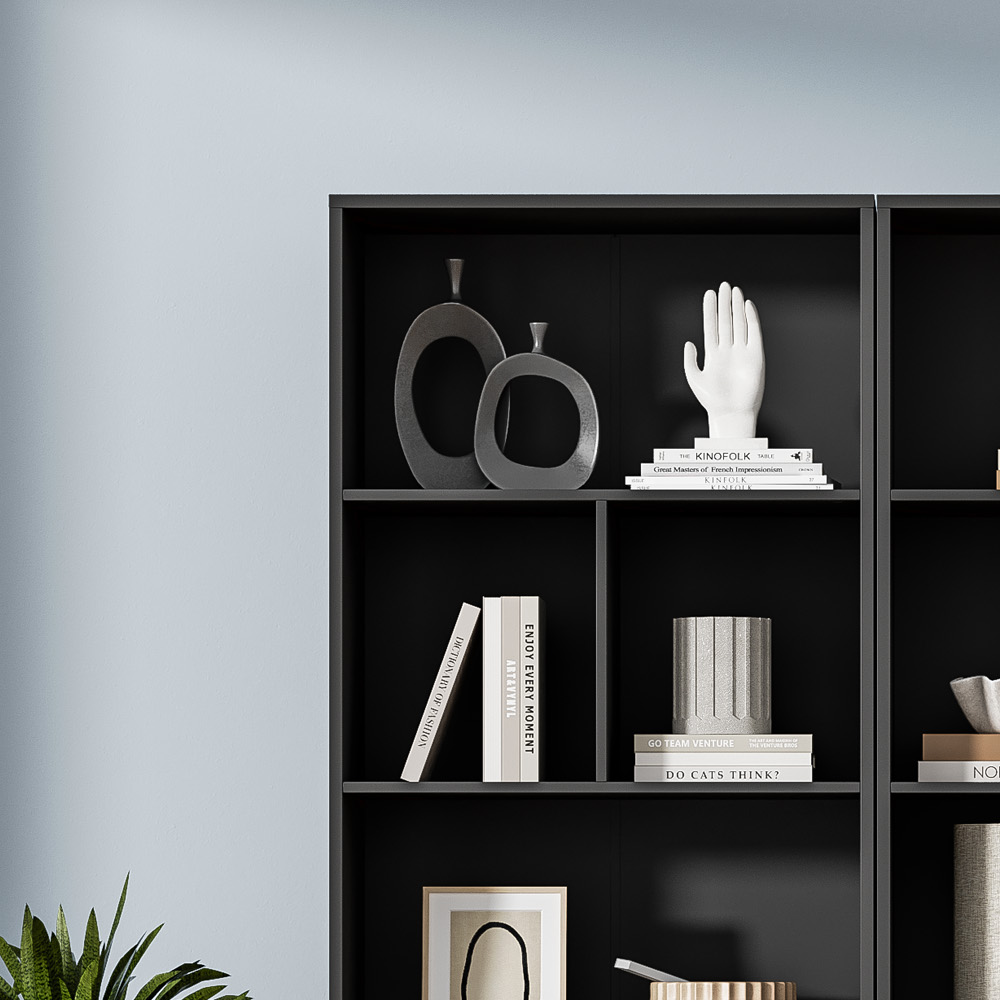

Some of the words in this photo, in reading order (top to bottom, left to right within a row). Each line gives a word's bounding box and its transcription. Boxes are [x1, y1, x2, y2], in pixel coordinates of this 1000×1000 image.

[695, 452, 751, 461] KINOFOLK
[701, 465, 709, 473] of
[735, 466, 783, 474] Impressionism
[704, 476, 747, 484] KINFOLK
[524, 624, 534, 660] ENJOY
[438, 636, 464, 692] DICTIONARY
[524, 665, 534, 700] EVERY
[433, 693, 444, 707] OF
[418, 707, 438, 749] FASHION
[524, 705, 534, 754] MOMENT
[648, 740, 662, 748] GO
[664, 740, 690, 748] TEAM
[692, 740, 735, 748] VENTURE
[666, 770, 685, 780] DO
[691, 770, 724, 780] CATS
[730, 770, 780, 780] THINK?
